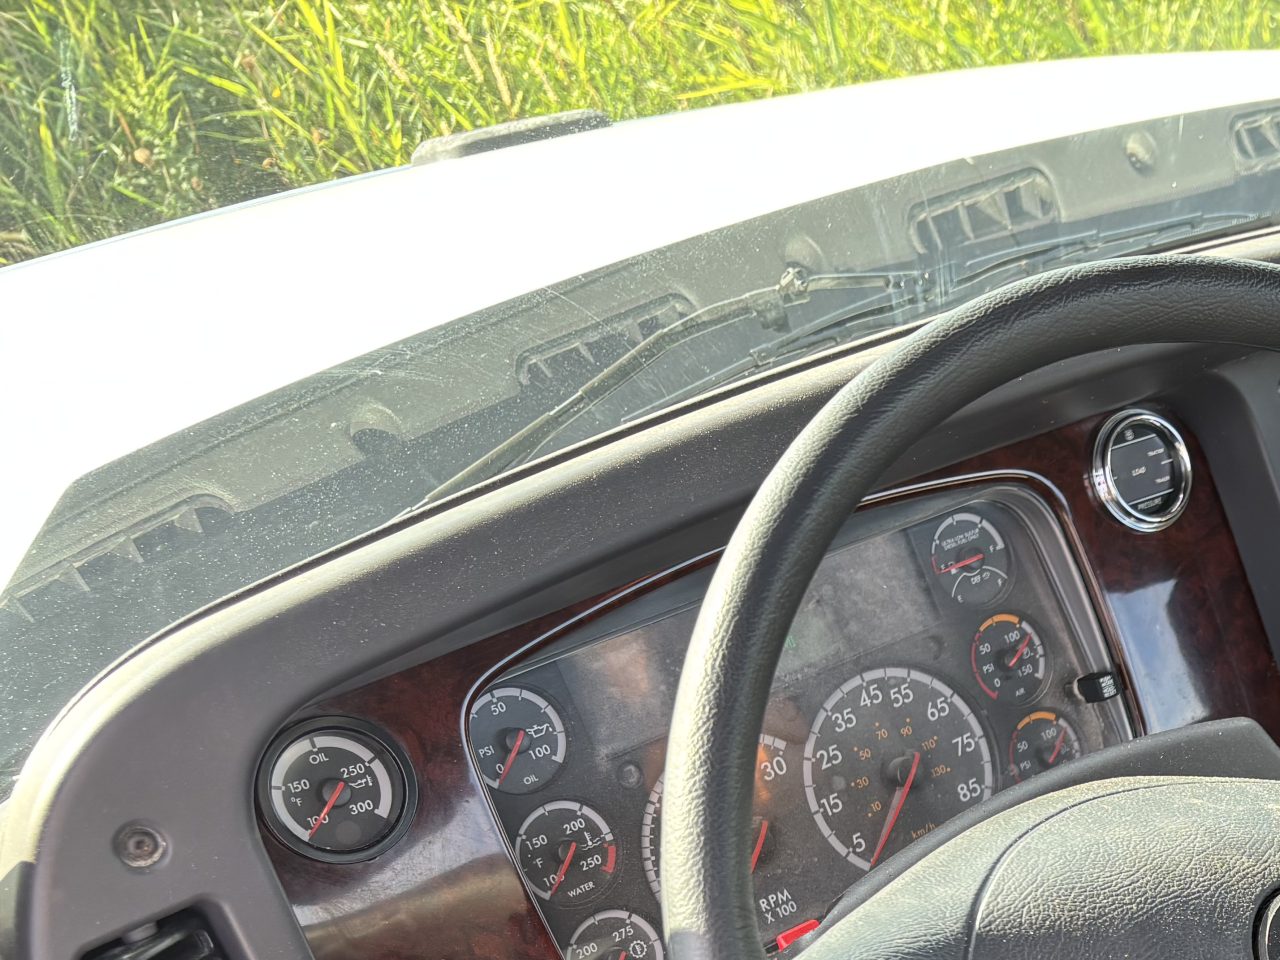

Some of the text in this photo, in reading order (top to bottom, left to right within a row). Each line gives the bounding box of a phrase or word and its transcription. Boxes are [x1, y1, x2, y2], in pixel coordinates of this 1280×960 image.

[1004, 630, 1020, 644] 100
[979, 643, 991, 655] 50
[982, 663, 994, 674] PSI
[1018, 664, 1033, 678] 150
[859, 684, 883, 707] 45
[890, 684, 914, 708] 55
[491, 703, 507, 716] 50
[927, 698, 951, 722] 65
[832, 708, 857, 732] 35
[875, 728, 888, 740] 70
[900, 725, 913, 737] 90
[1040, 728, 1057, 740] 100
[478, 747, 495, 758] PSI
[529, 744, 551, 760] 100
[922, 740, 936, 750] 110
[952, 734, 977, 757] 75
[1017, 741, 1028, 753] 50
[309, 753, 329, 765] OIL
[816, 745, 843, 770] 25
[859, 748, 872, 760] 50
[340, 763, 366, 778] 250
[496, 764, 504, 774] 0
[760, 757, 787, 782] 30
[931, 765, 946, 777] 130
[1020, 760, 1032, 771] PSI
[288, 779, 310, 794] 150
[523, 774, 540, 785] OIL
[856, 776, 870, 788] 30
[957, 779, 982, 803] 85
[349, 800, 374, 816] 300
[821, 793, 843, 817] 15
[870, 800, 882, 812] 10
[306, 814, 329, 827] 100
[563, 818, 586, 835] 200
[911, 822, 936, 840] km/h
[526, 834, 548, 850] 150
[852, 832, 867, 854] 5
[580, 855, 602, 871] 250
[567, 881, 596, 898] WATER
[759, 888, 792, 913] RPM
[765, 902, 798, 925] X 100
[612, 925, 634, 942] 275
[576, 942, 598, 960] 200
